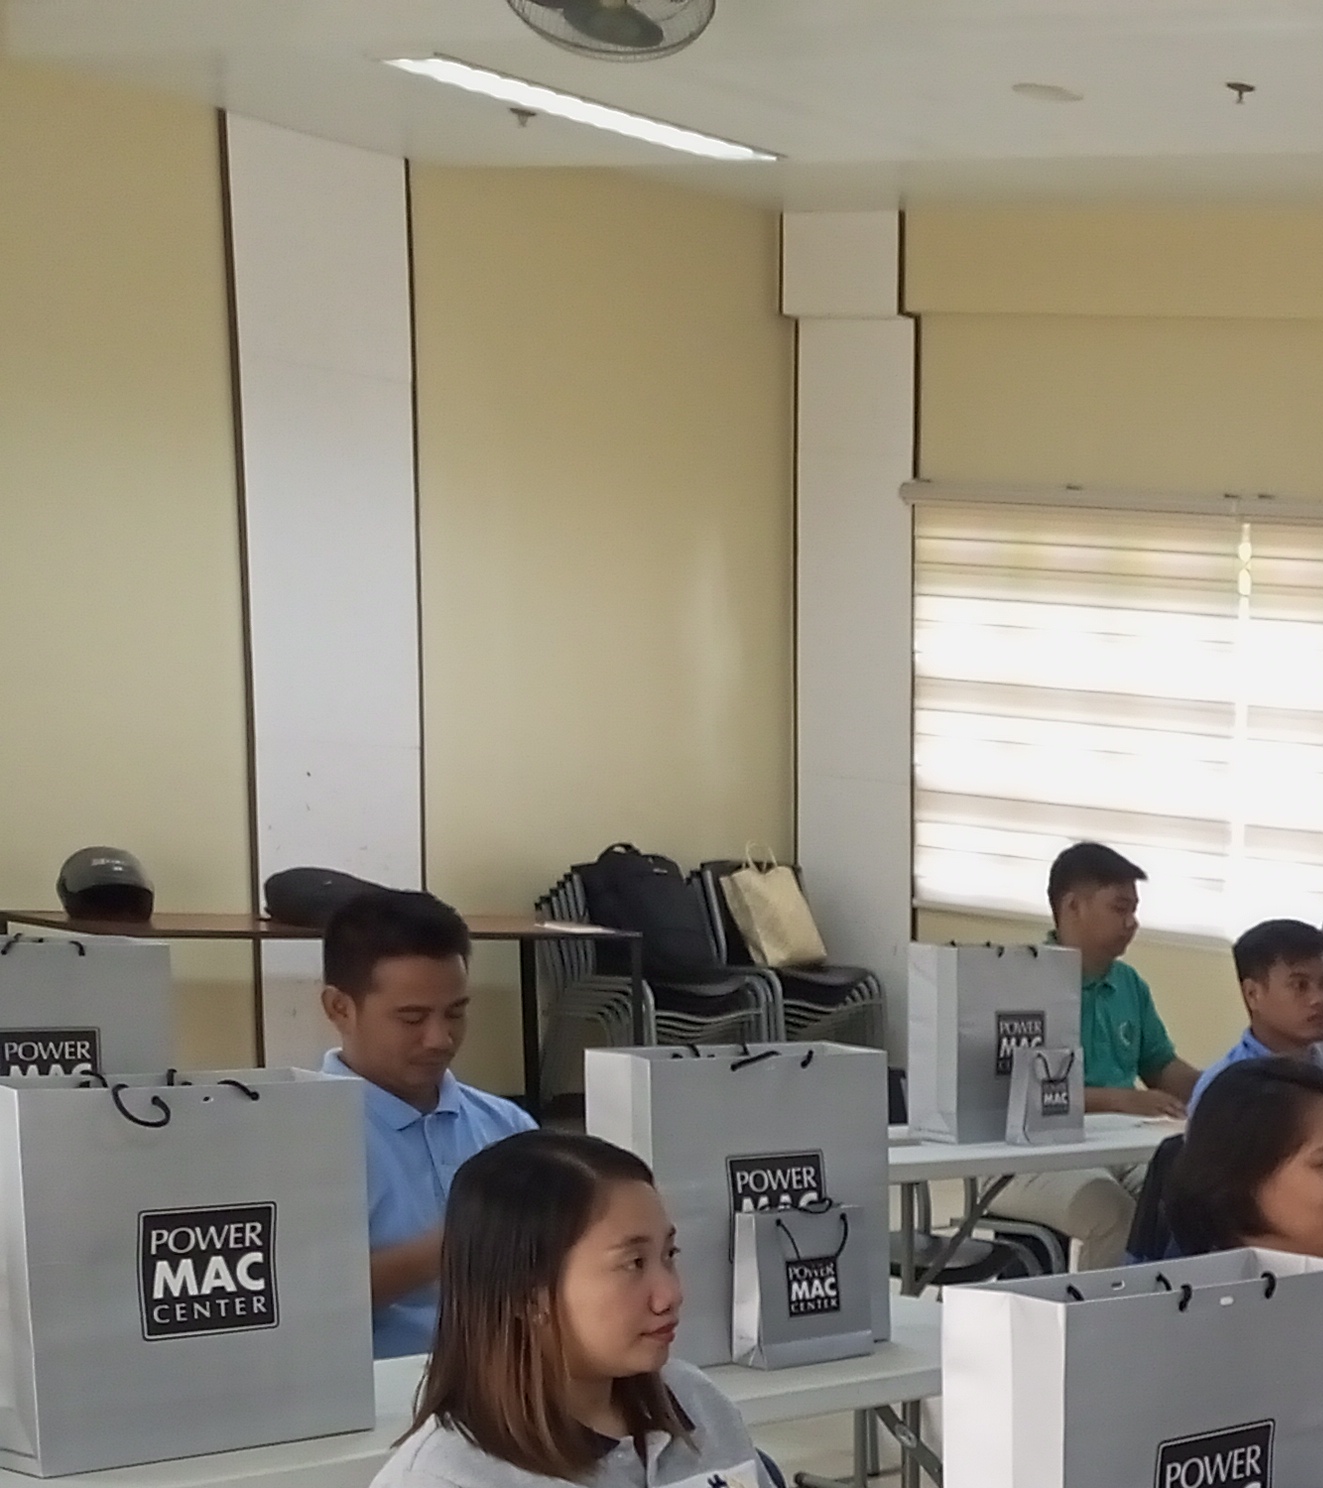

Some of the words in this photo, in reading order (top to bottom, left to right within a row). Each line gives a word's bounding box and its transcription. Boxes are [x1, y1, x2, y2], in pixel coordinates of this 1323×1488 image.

[4, 1041, 91, 1061] POWER
[736, 1166, 817, 1194] POWER
[150, 1222, 263, 1255] POWER
[152, 1251, 265, 1300] MAC
[789, 1263, 835, 1281] POWER
[791, 1277, 837, 1301] MAC
[153, 1295, 267, 1324] CENTER
[791, 1299, 838, 1313] CENTER
